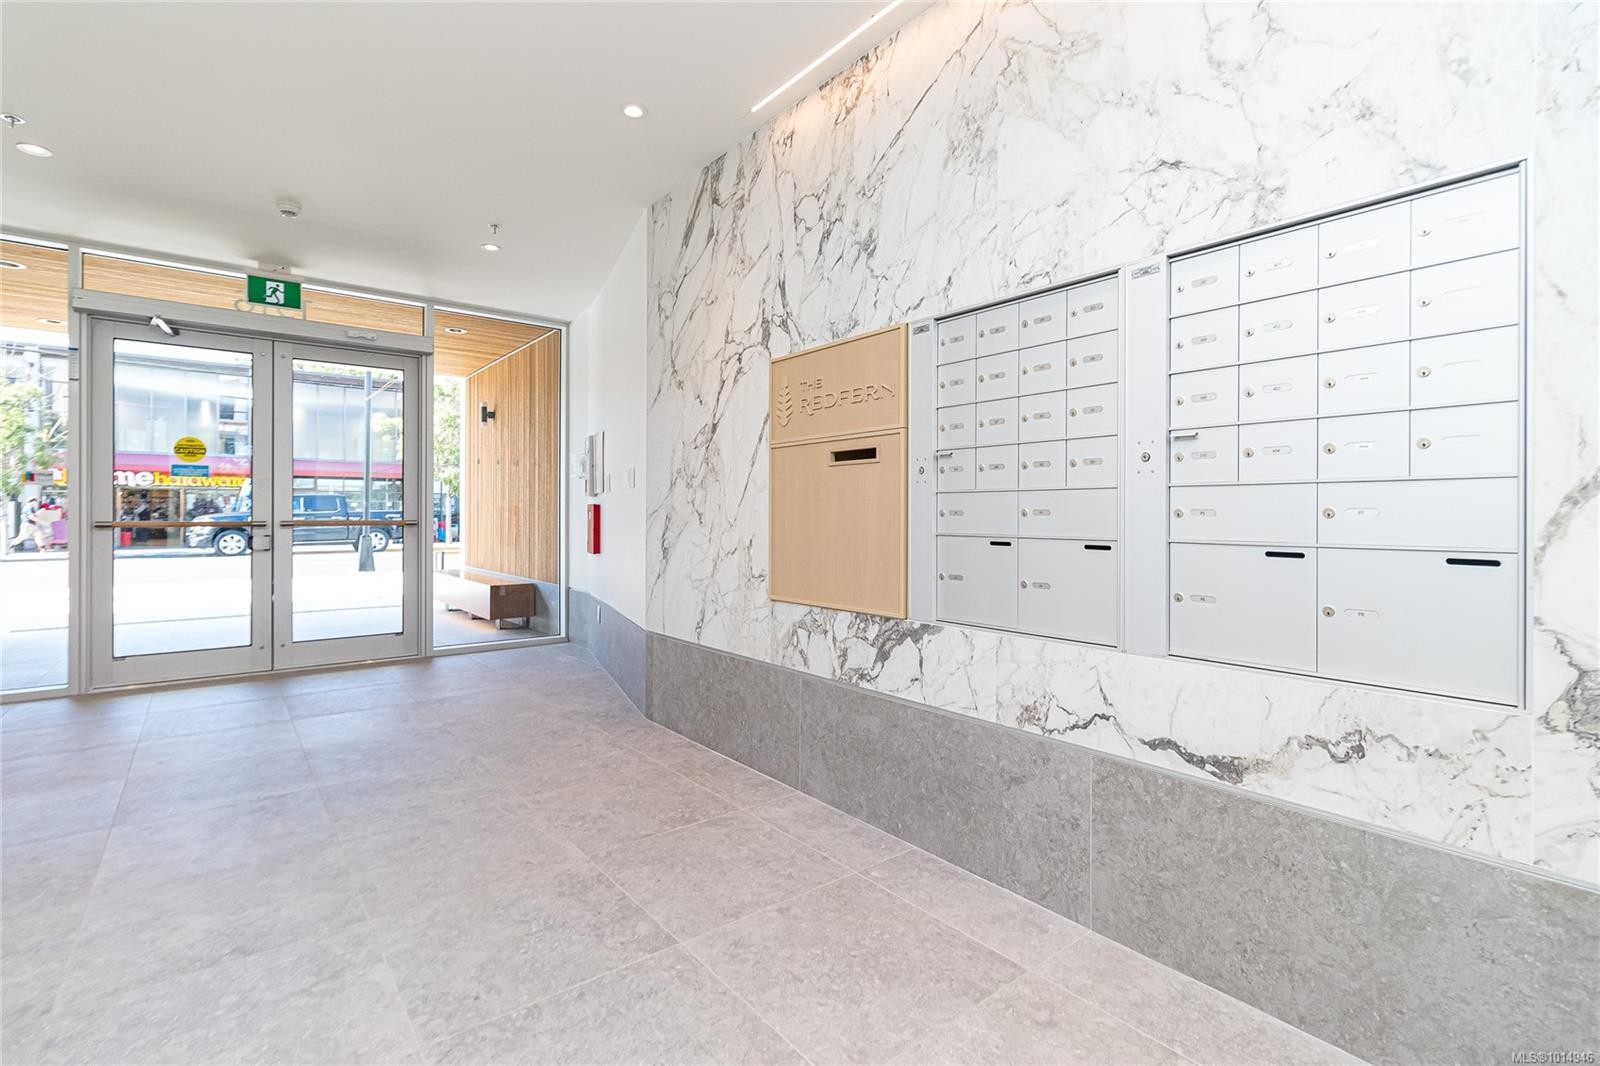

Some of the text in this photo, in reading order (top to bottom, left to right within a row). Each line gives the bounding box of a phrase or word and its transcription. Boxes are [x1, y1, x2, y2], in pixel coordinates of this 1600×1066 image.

[799, 377, 823, 393] THE
[799, 383, 897, 417] REDFERN
[175, 447, 206, 455] CAUTION
